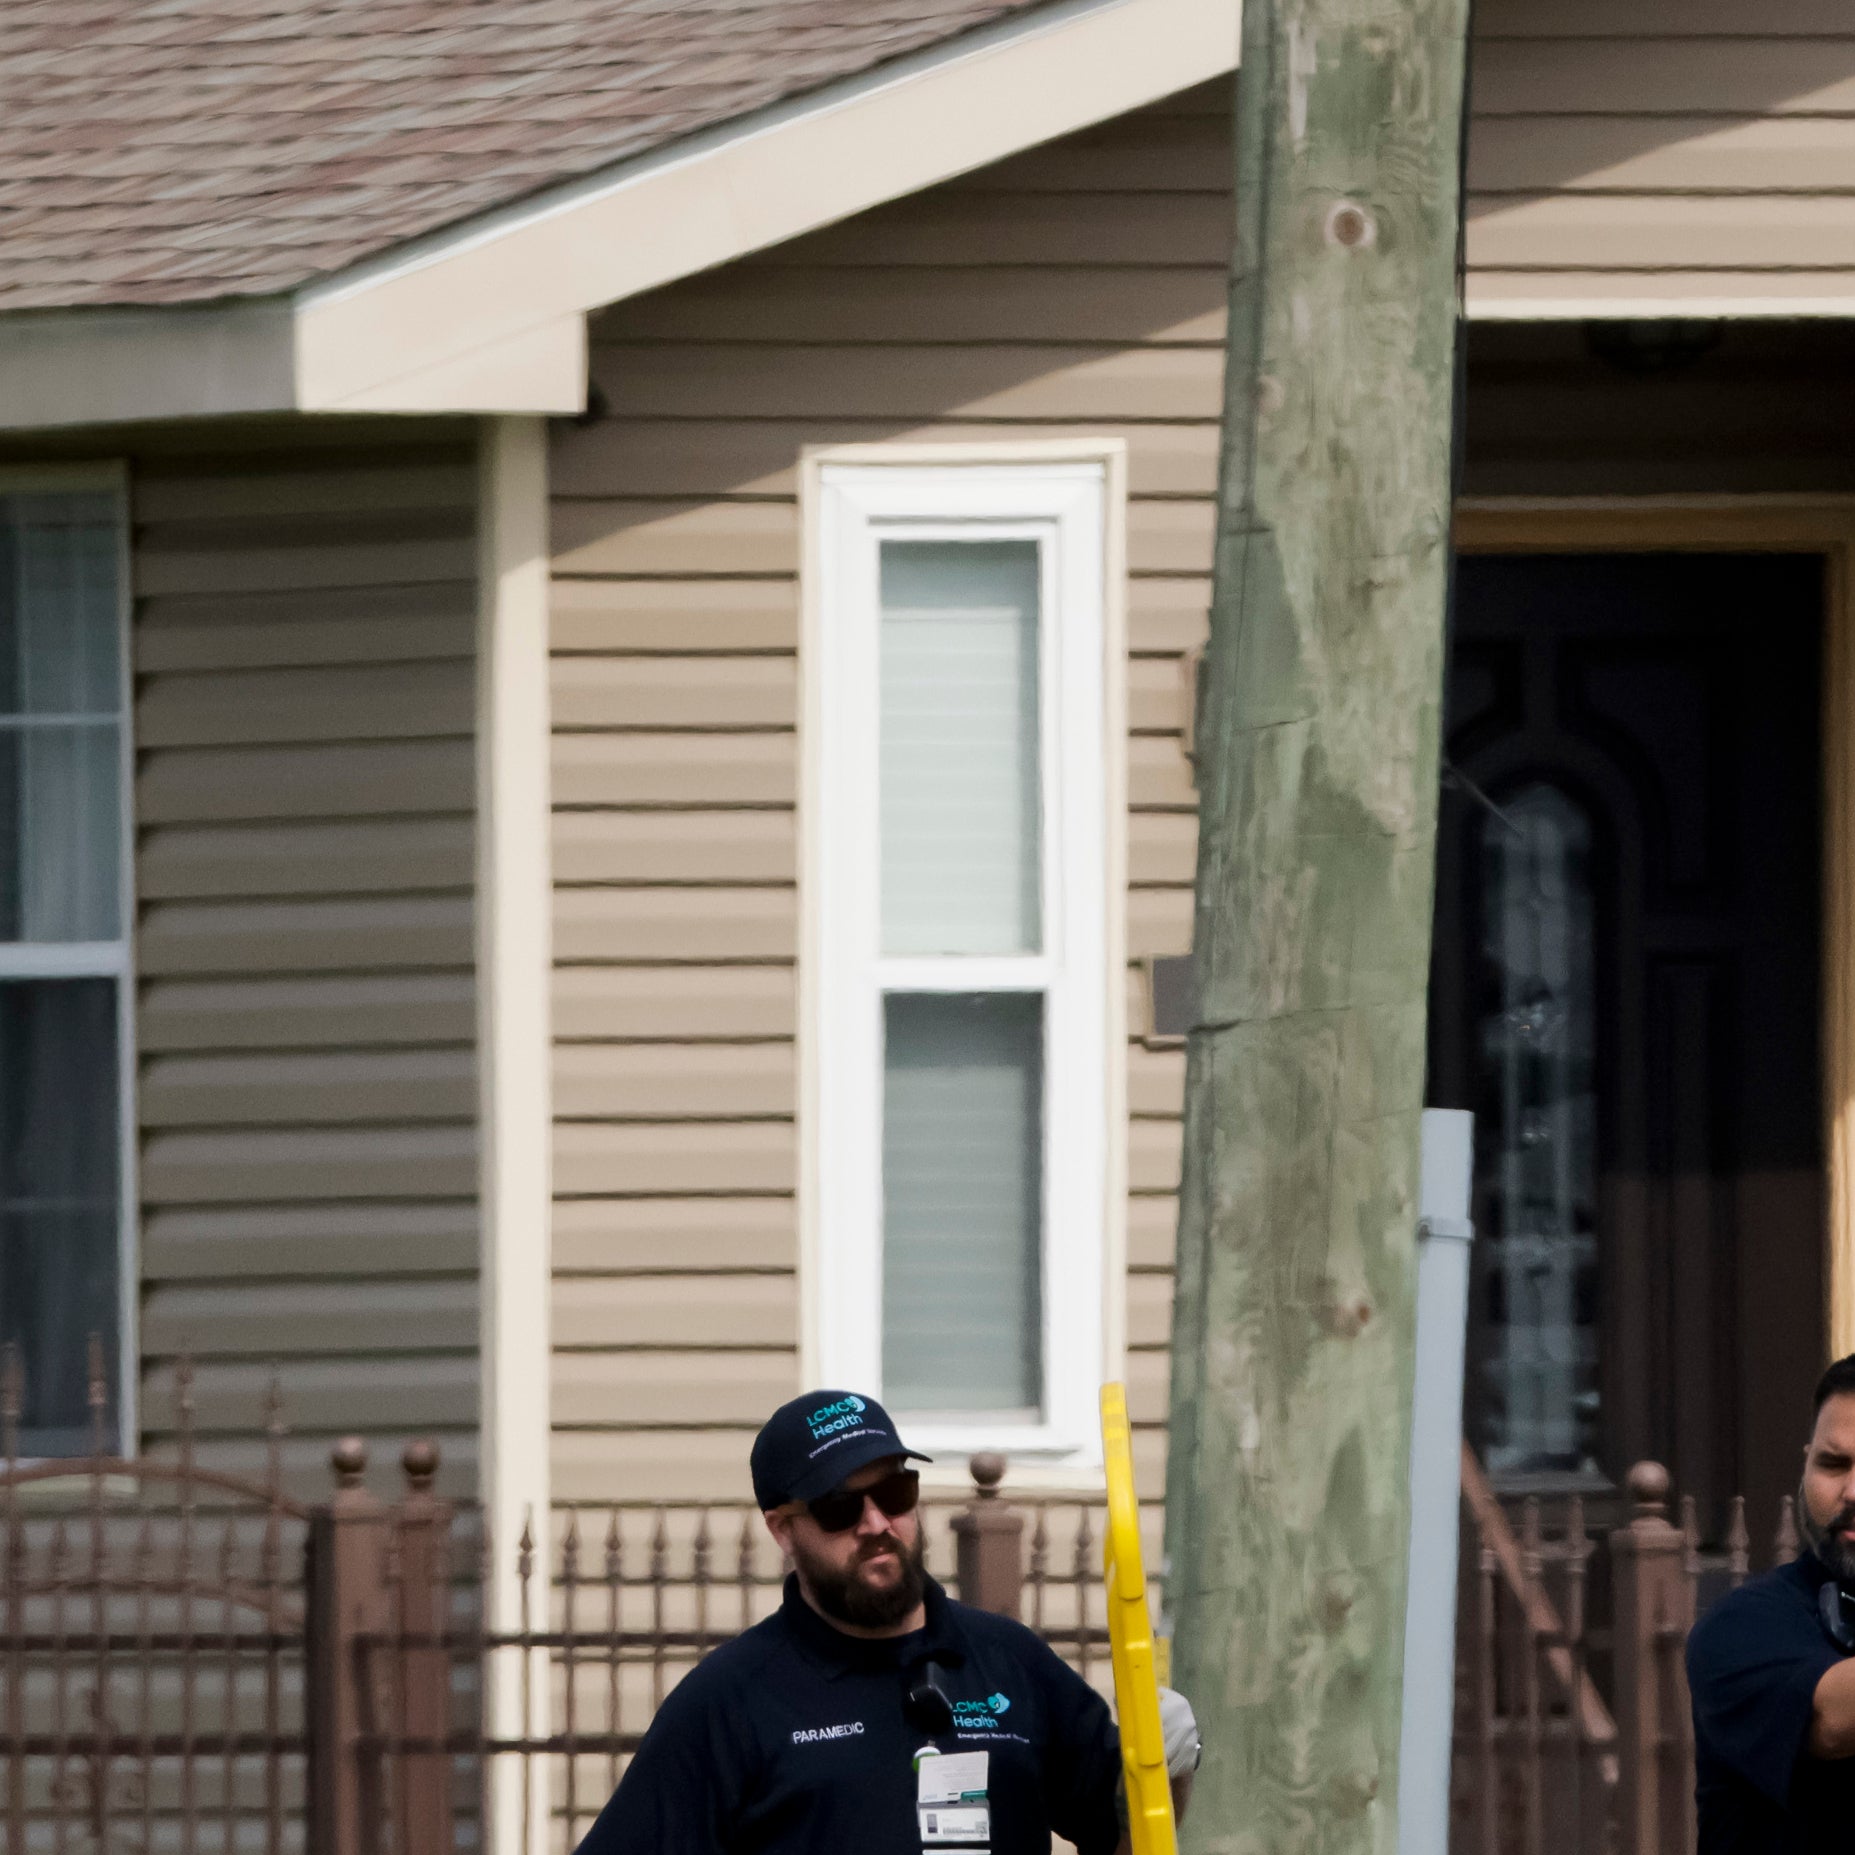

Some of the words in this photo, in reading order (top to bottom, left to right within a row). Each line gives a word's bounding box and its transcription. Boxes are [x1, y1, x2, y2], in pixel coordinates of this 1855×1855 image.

[806, 1401, 850, 1427] LCMC
[812, 1414, 863, 1440] Health
[792, 1721, 865, 1745] PARAMEDIC
[953, 1714, 999, 1728] Health
